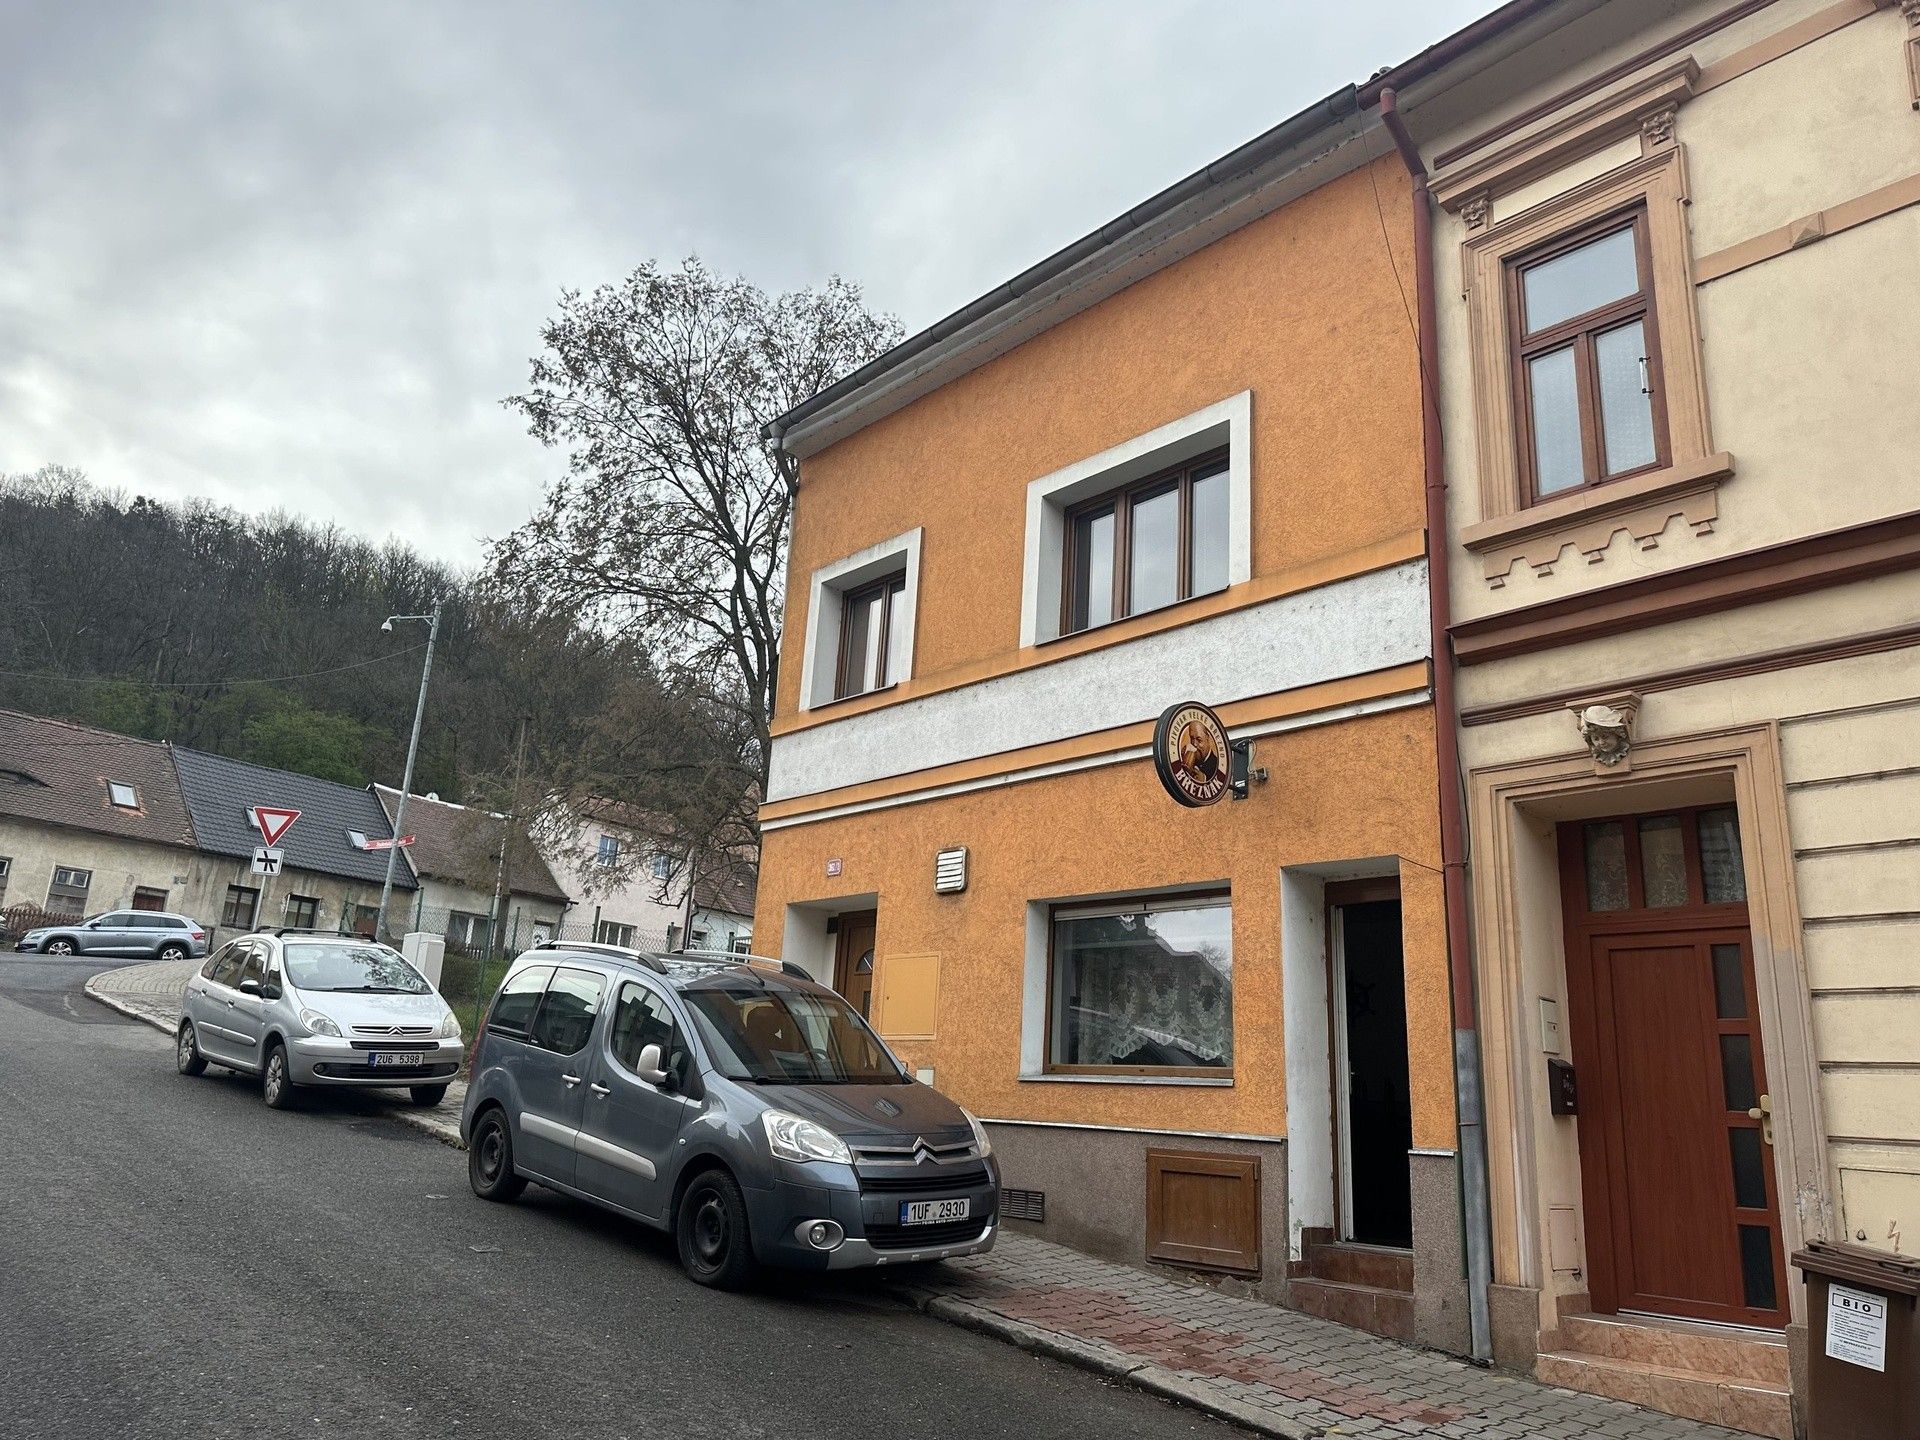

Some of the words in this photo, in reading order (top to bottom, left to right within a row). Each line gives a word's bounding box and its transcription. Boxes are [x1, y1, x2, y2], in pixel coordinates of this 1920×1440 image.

[1171, 713, 1188, 746] PIVOVAR
[377, 1055, 393, 1064] 2U6
[399, 1055, 420, 1064] 5398
[911, 1203, 931, 1220] 1UF
[938, 1200, 965, 1218] 2930
[1842, 1298, 1871, 1313] BIO
